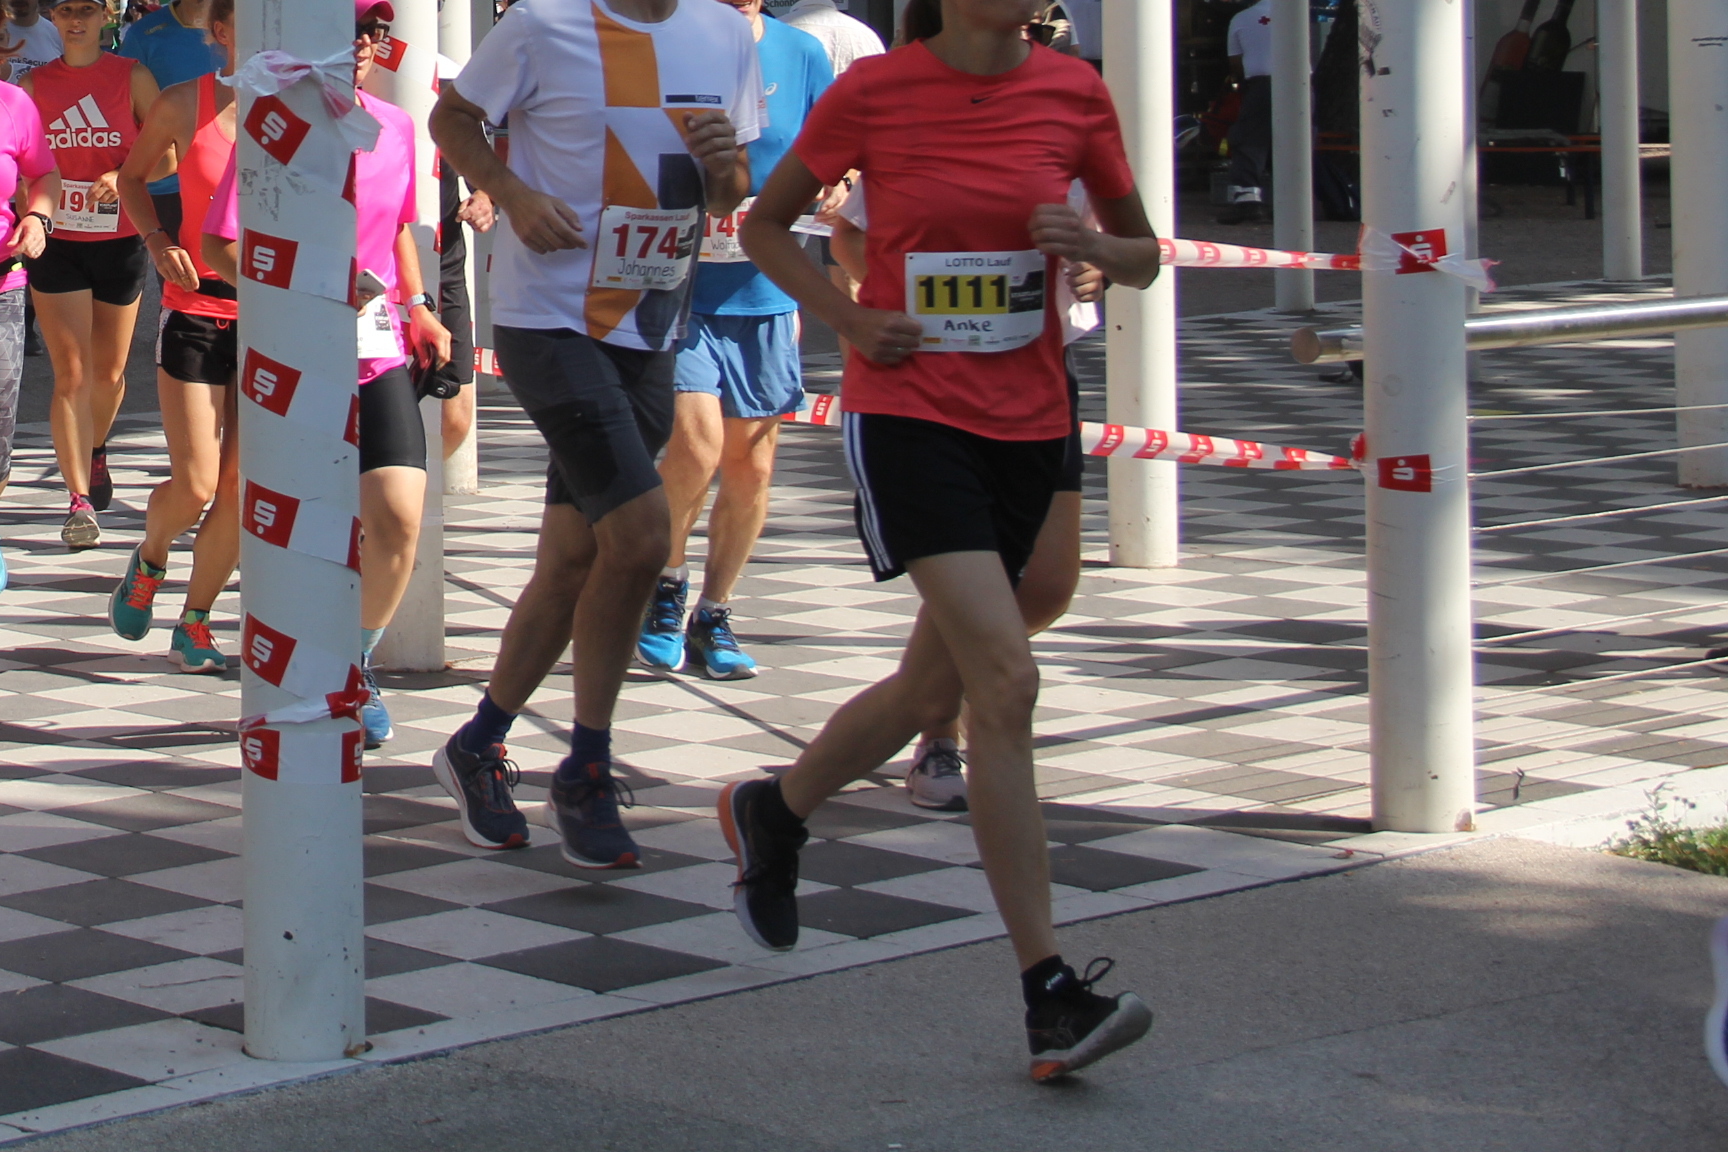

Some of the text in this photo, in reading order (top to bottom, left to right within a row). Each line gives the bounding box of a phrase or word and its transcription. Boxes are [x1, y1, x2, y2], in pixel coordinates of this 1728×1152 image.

[45, 128, 122, 150] adidas
[625, 211, 674, 223] Sparkassen
[612, 223, 679, 260] 174
[617, 257, 676, 278] Johannes
[945, 256, 1012, 268] LOTTO Lauf
[918, 275, 1007, 308] 1111
[943, 319, 994, 333] Anke
